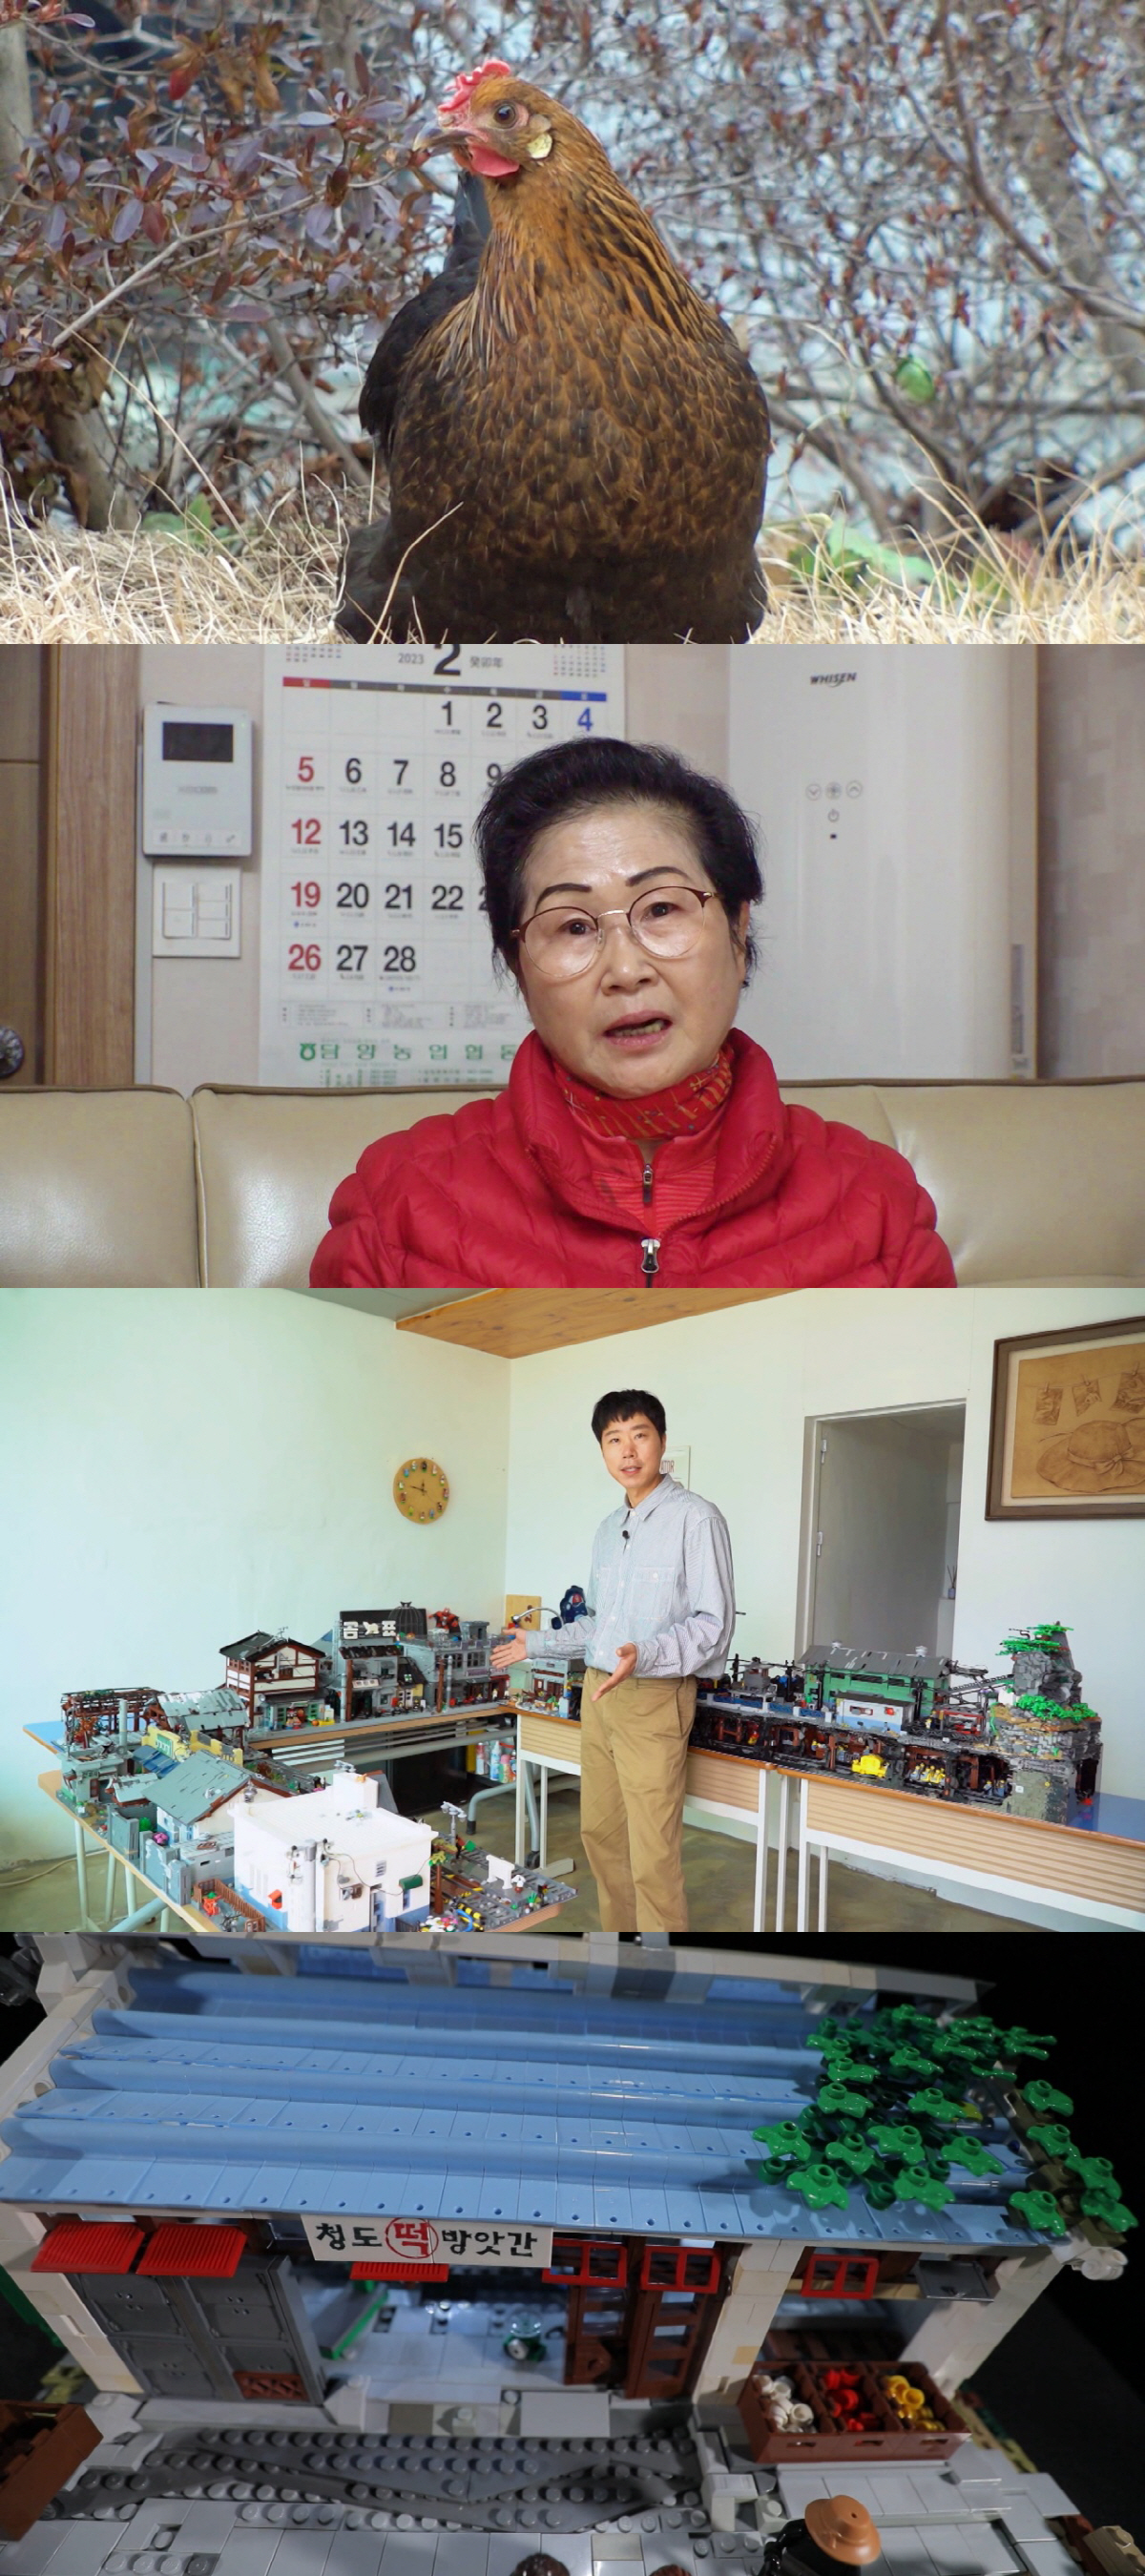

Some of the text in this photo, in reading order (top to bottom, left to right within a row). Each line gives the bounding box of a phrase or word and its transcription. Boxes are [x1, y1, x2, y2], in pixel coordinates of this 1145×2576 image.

[398, 653, 425, 665] 2023
[433, 644, 462, 676] 2
[810, 672, 857, 687] WHISEN
[441, 700, 594, 732] 1 2 3 4
[297, 756, 502, 788] 5 6 7 8 9
[291, 818, 464, 849] 12 13 14 15
[290, 881, 322, 908] 19
[337, 882, 370, 908] 20
[385, 883, 413, 910] 21
[431, 884, 464, 911] 22
[288, 944, 417, 973] 26 27 28
[315, 2222, 538, 2257] 청도 떡 방앗간
